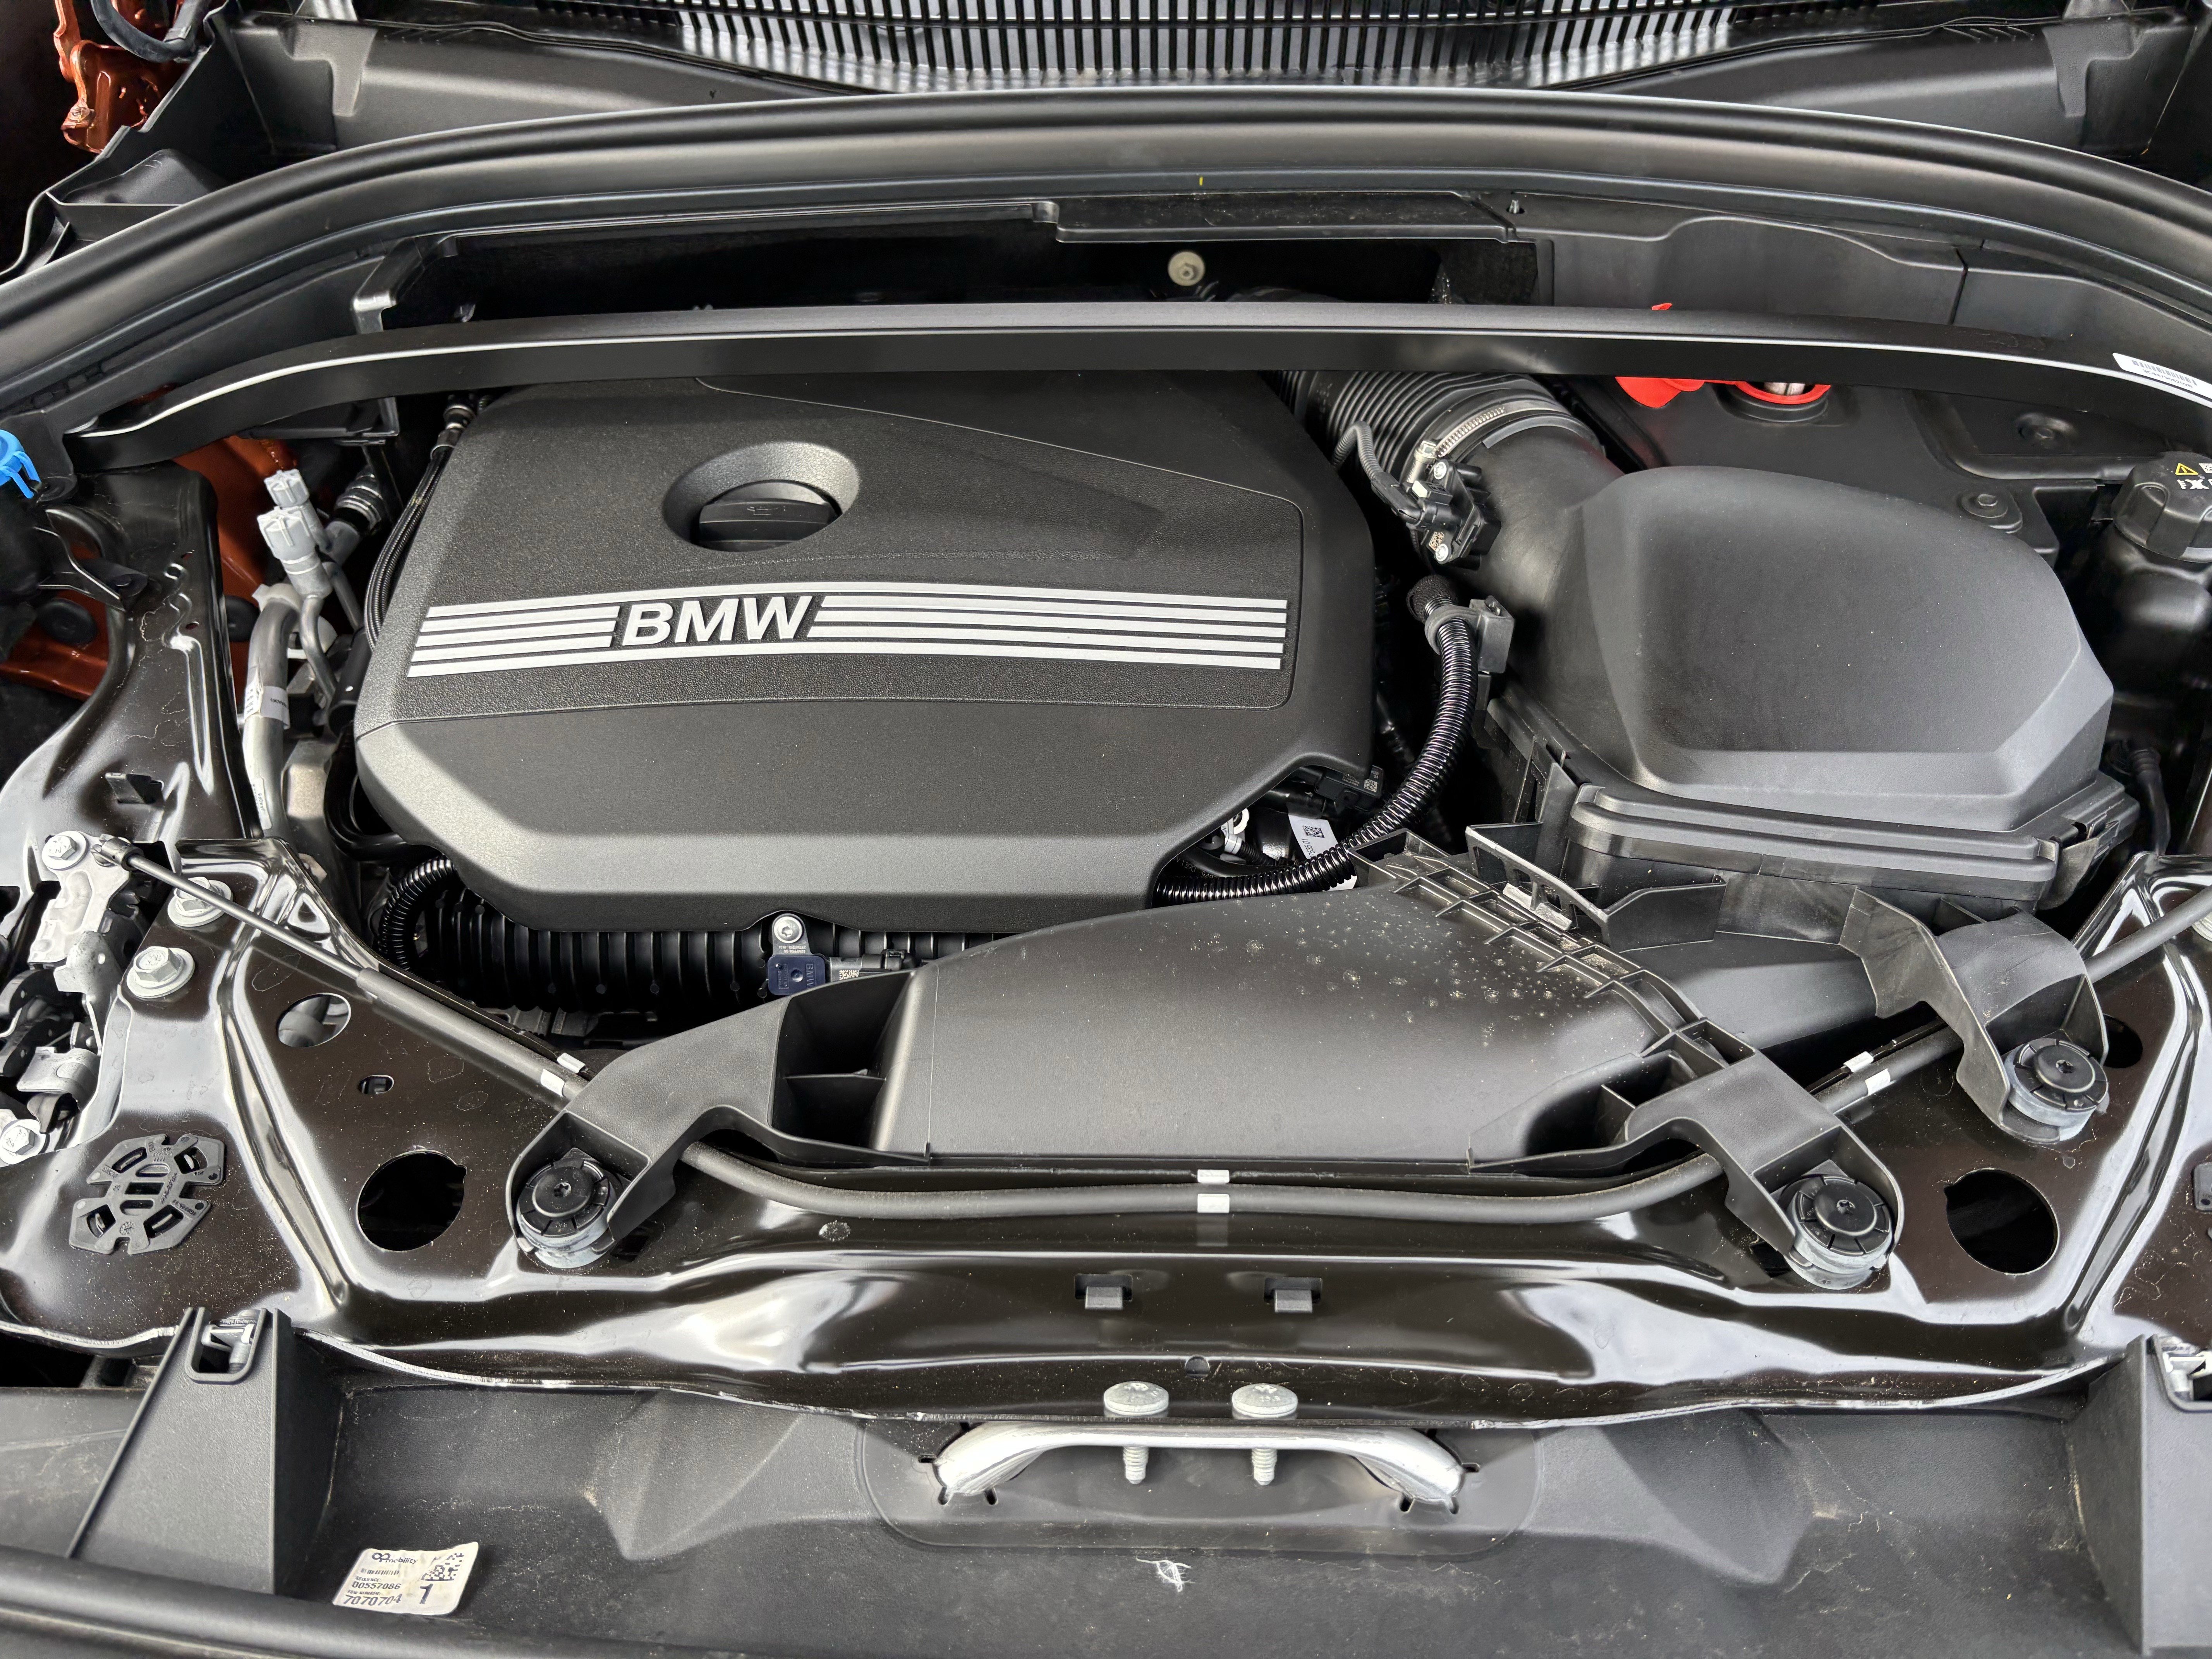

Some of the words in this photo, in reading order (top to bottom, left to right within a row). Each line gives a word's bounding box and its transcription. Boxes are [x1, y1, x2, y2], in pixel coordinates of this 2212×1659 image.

[622, 596, 813, 646] BMW
[352, 1581, 402, 1590] 00557086
[419, 1583, 434, 1604] 1
[343, 1593, 403, 1606] 7070704
